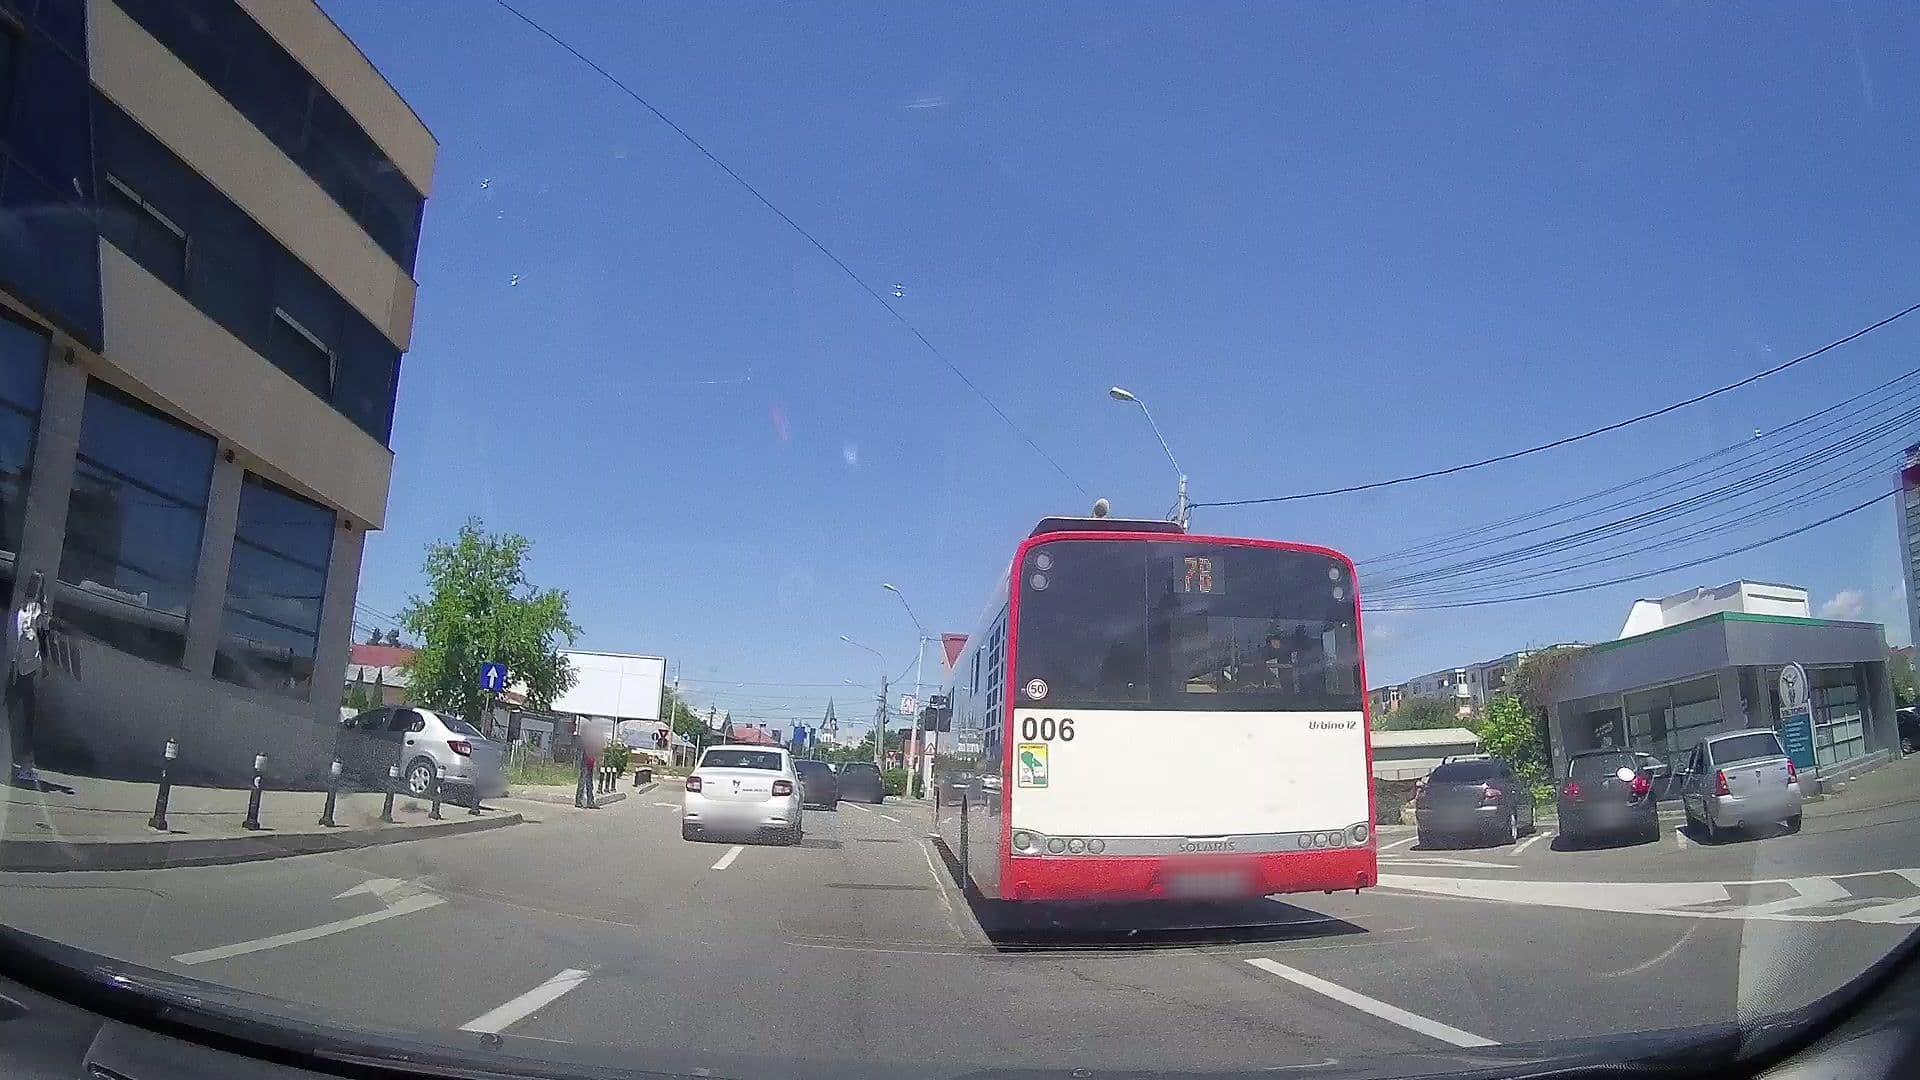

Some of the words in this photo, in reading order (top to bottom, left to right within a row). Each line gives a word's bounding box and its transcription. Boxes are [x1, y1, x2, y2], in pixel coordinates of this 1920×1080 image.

[1031, 685, 1044, 694] 50
[1022, 717, 1075, 741] 006
[1308, 720, 1345, 729] Urbino
[1346, 720, 1357, 729] 12
[1179, 841, 1236, 852] SOLARIS
